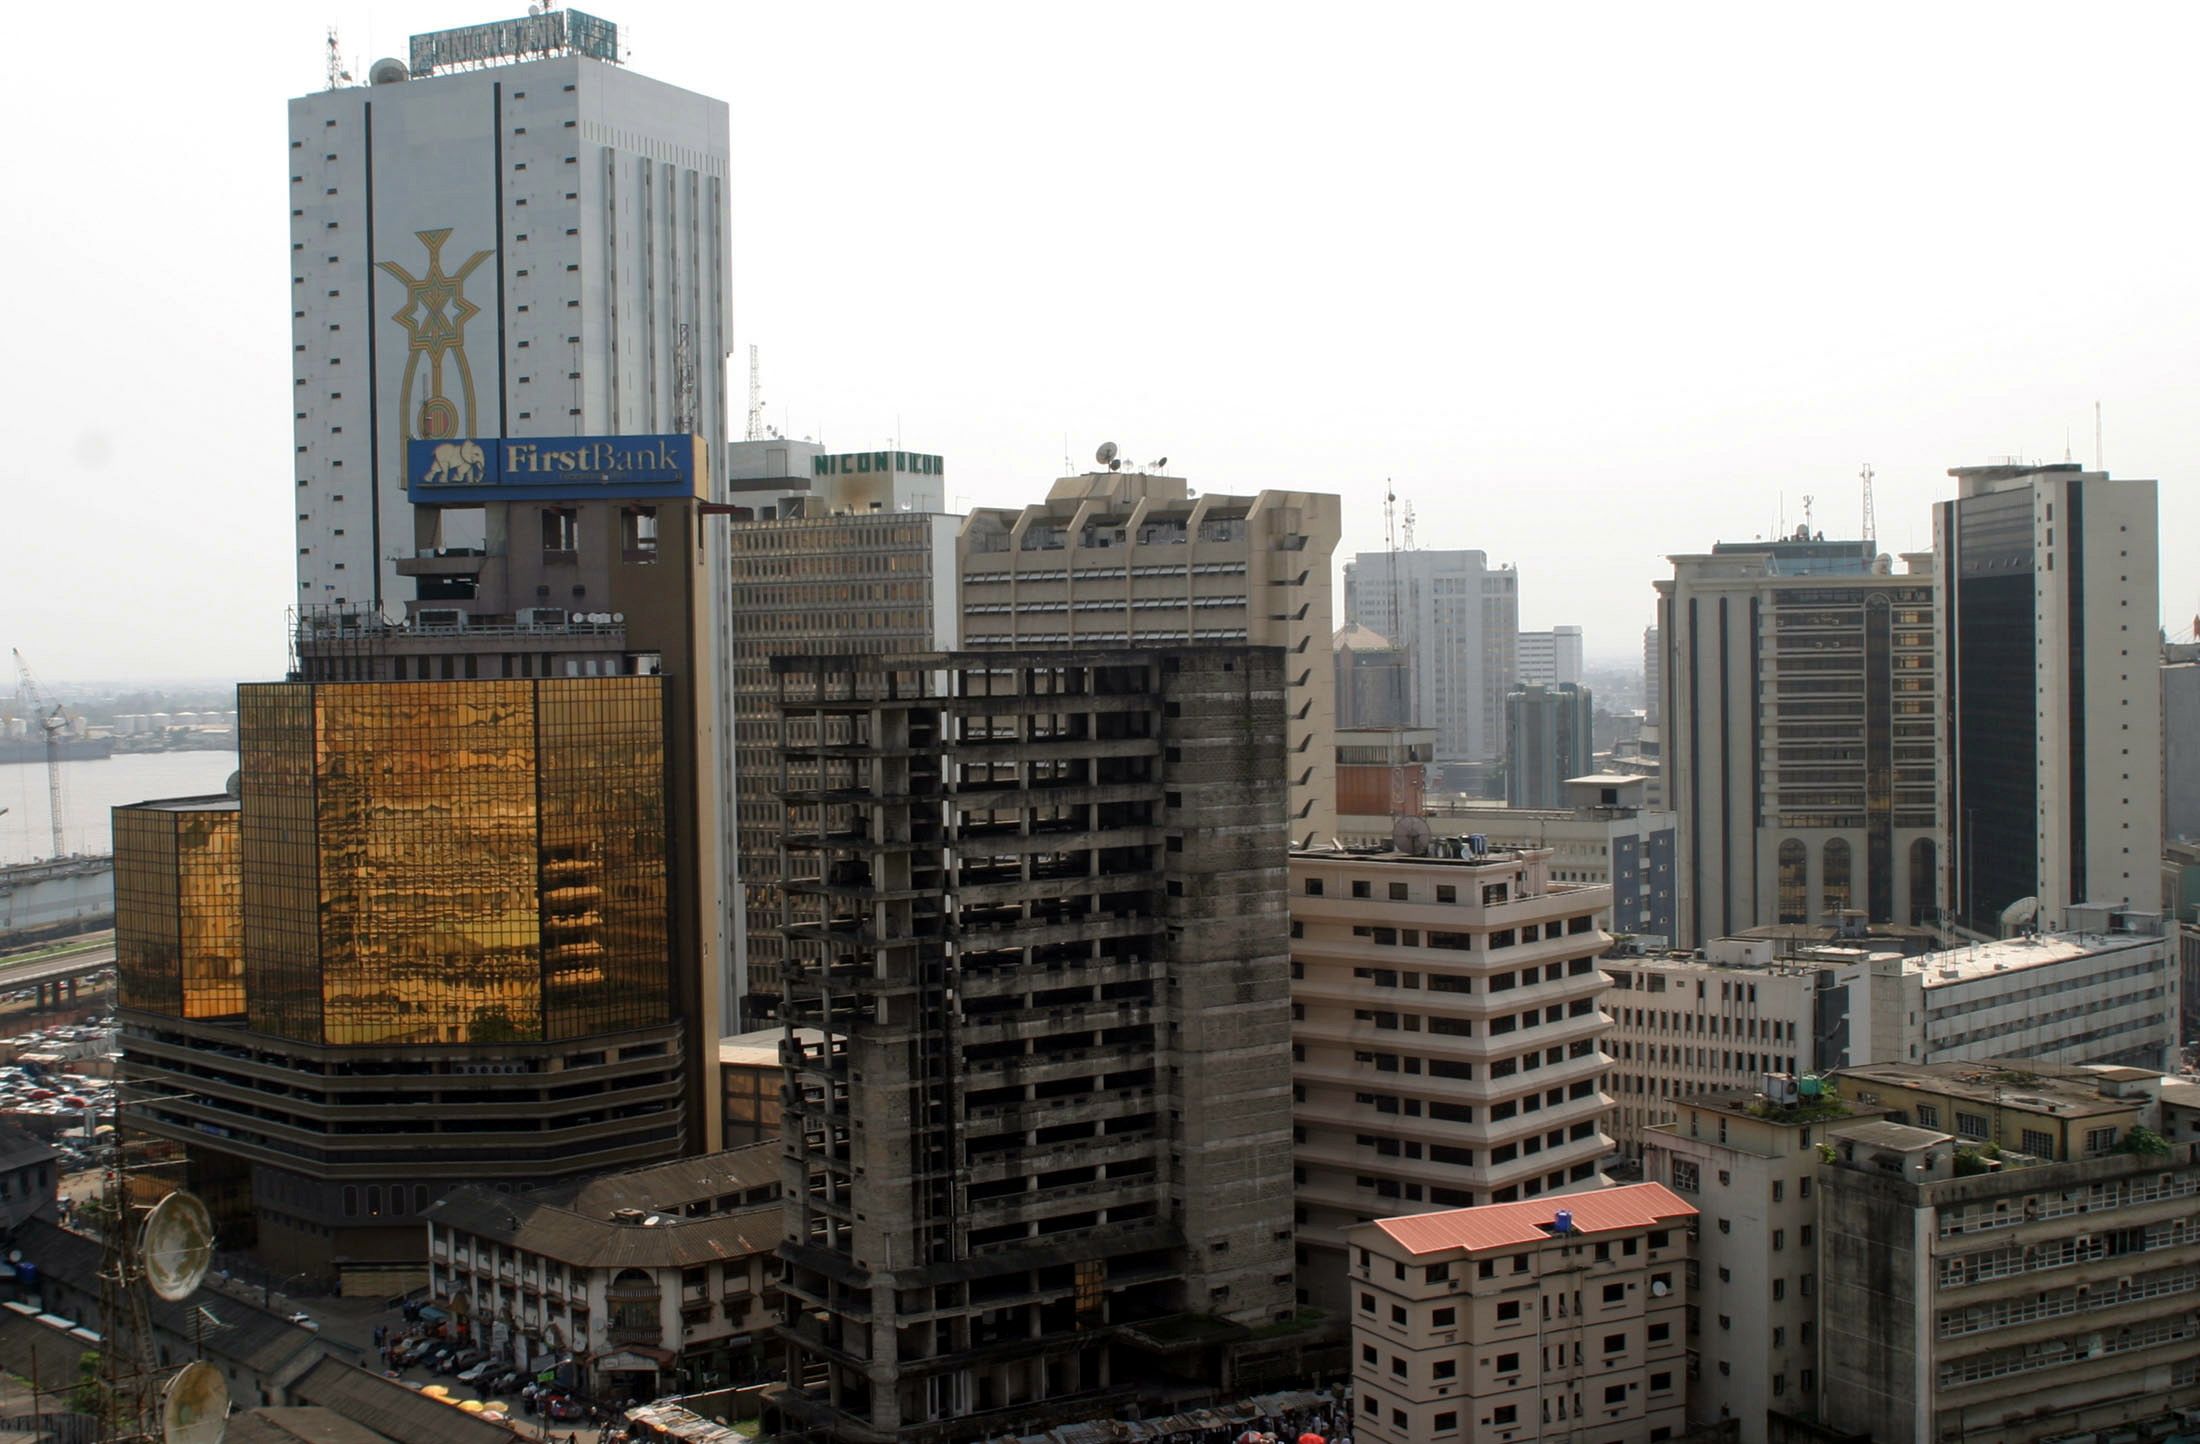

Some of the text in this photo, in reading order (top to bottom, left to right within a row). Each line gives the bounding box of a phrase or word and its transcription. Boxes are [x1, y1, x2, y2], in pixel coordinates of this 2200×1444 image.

[507, 440, 679, 473] FirstBank
[815, 451, 888, 475] NICON
[896, 451, 943, 475] NICON
